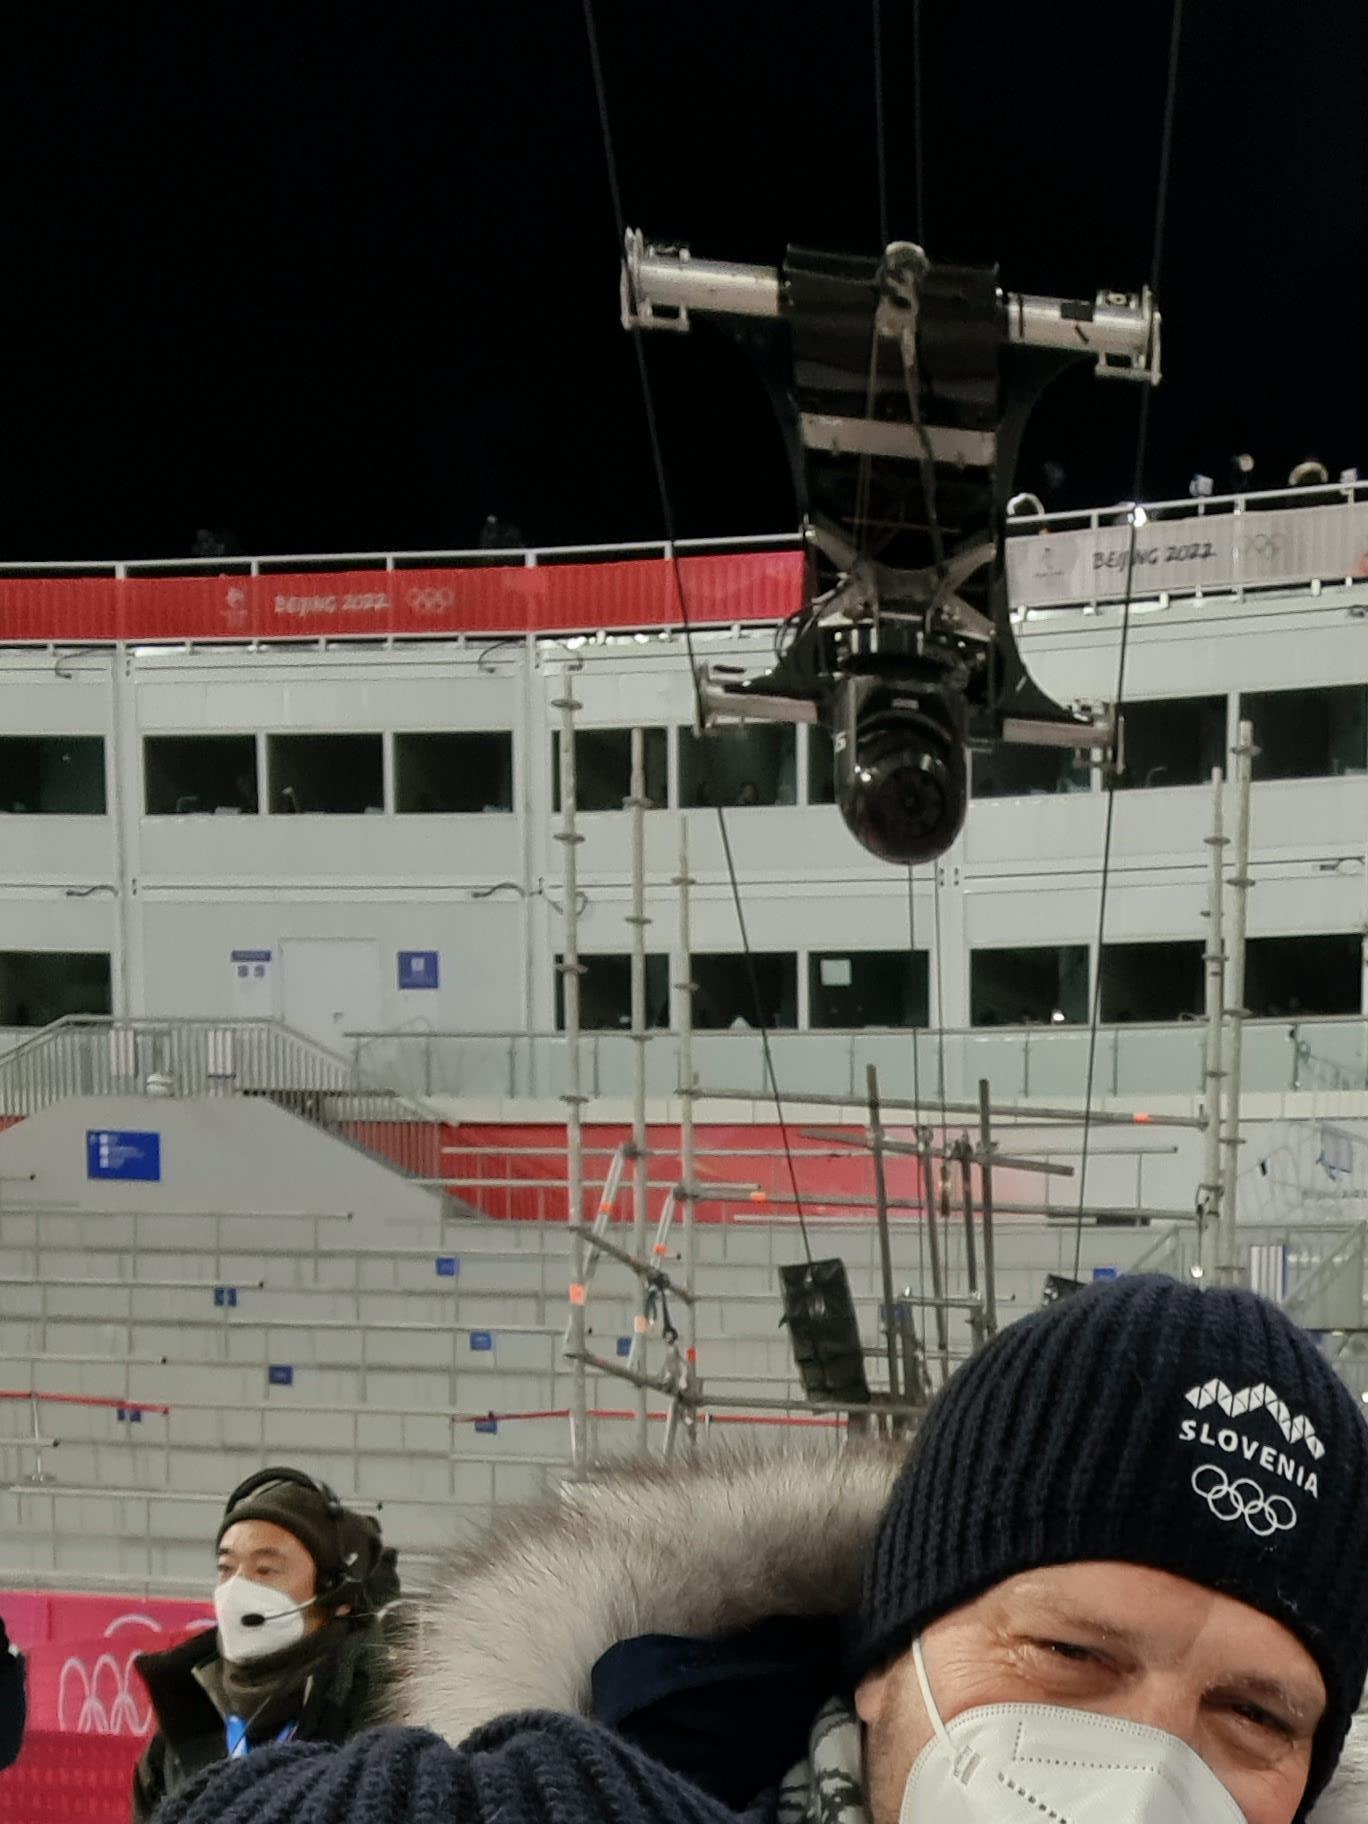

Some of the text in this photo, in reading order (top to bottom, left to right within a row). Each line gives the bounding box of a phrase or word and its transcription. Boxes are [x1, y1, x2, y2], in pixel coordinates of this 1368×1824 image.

[1093, 543, 1214, 571] BEIJING 2022
[274, 593, 389, 615] BEIJING 2022
[1179, 1419, 1318, 1499] SLOVENIA
